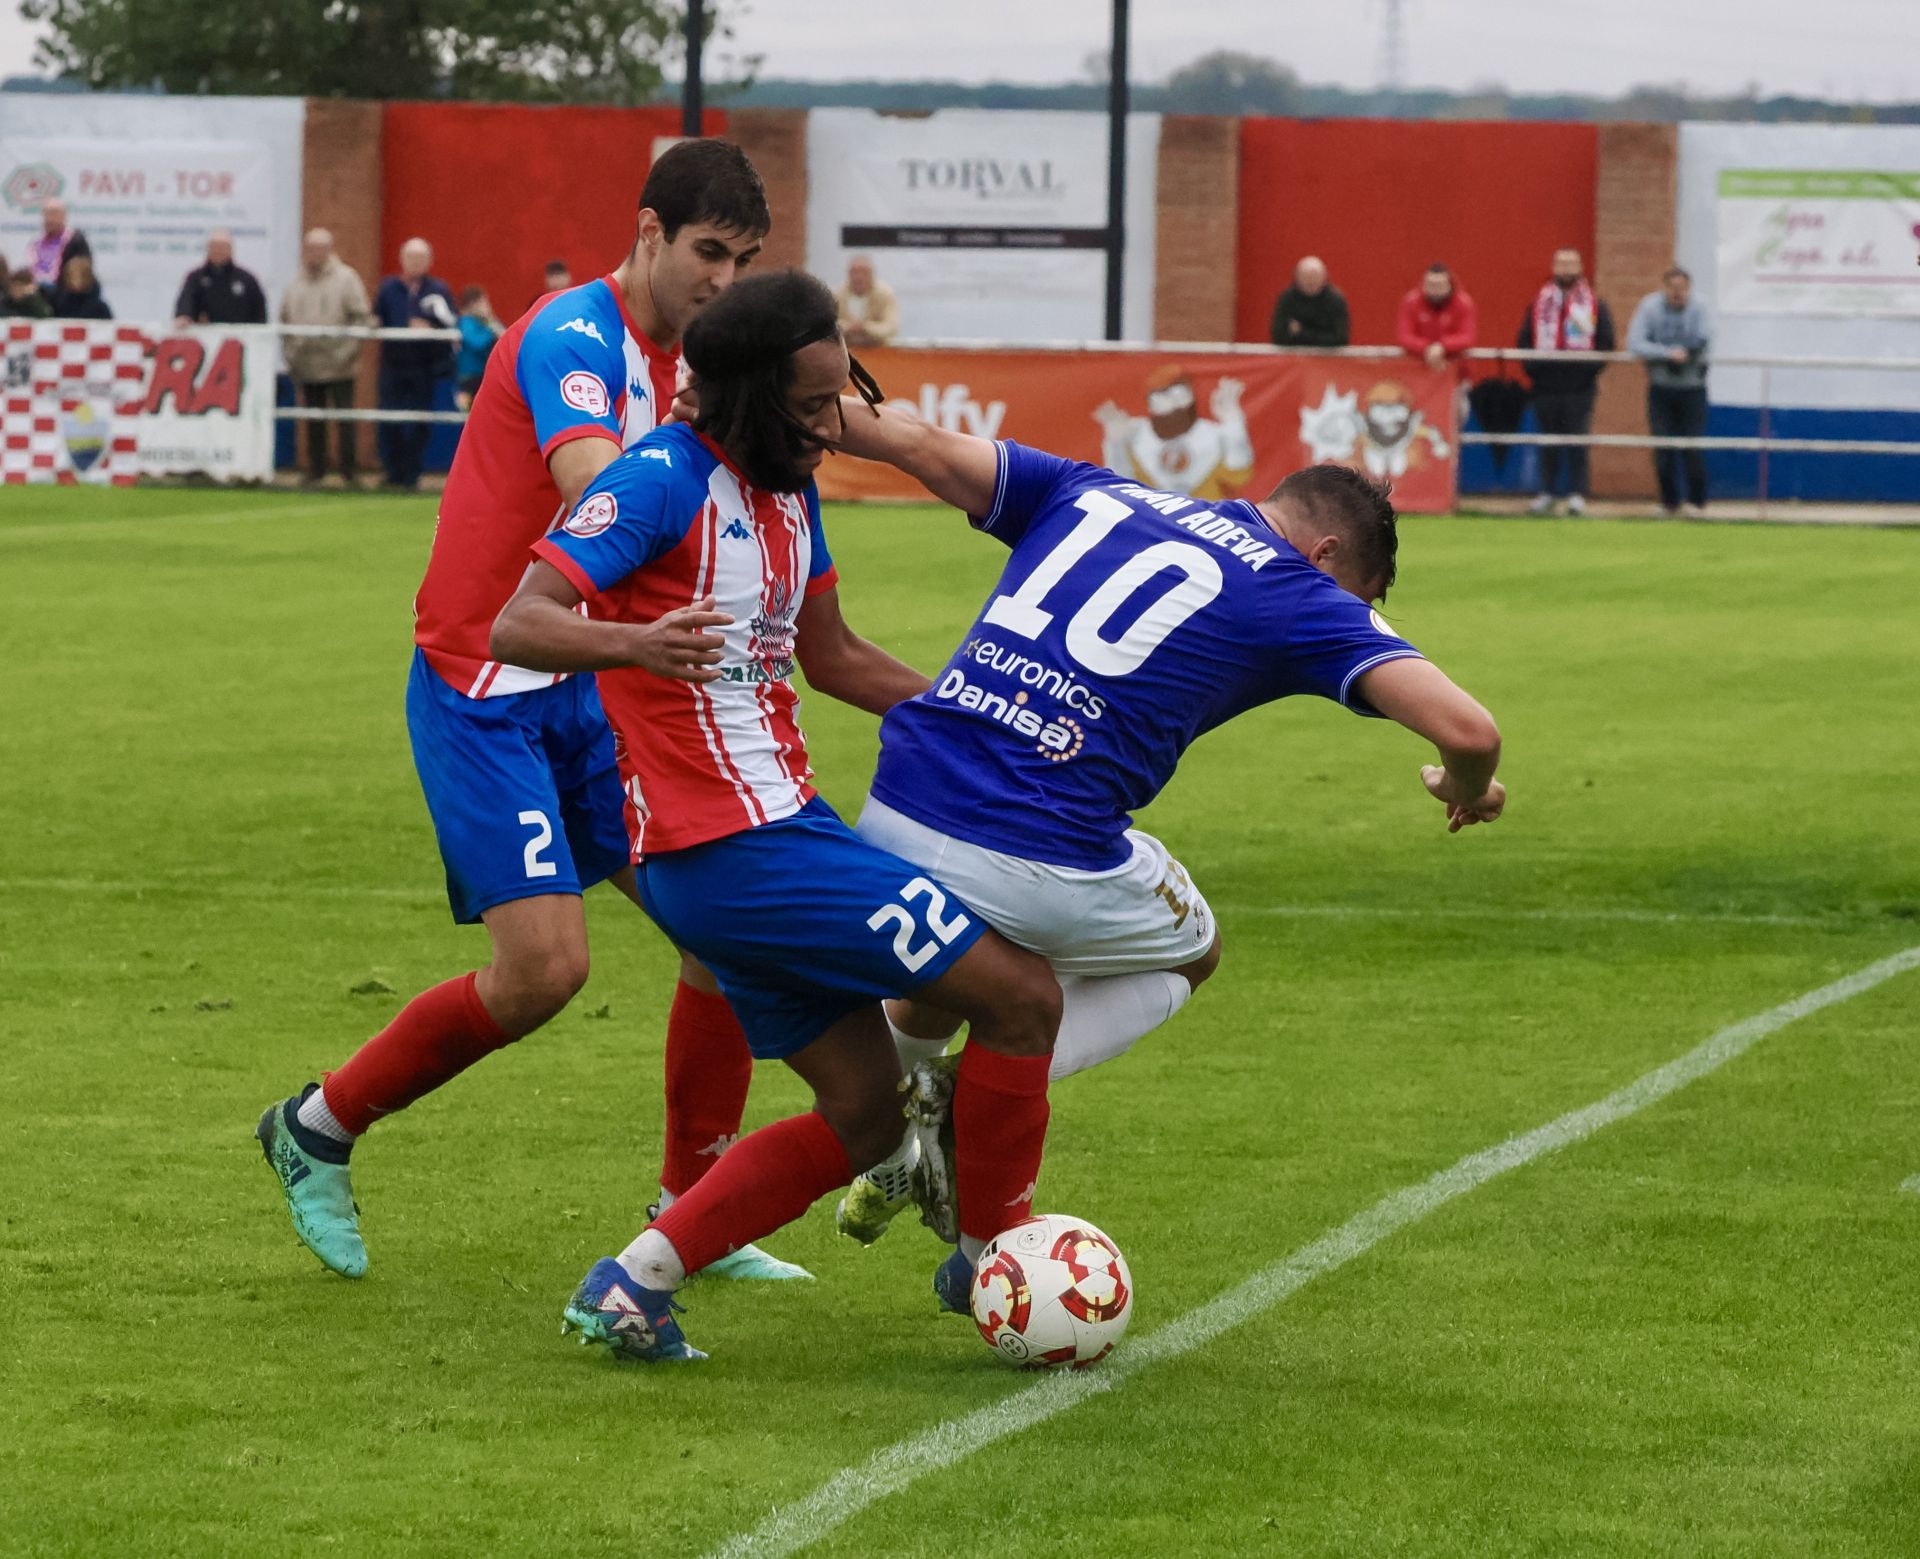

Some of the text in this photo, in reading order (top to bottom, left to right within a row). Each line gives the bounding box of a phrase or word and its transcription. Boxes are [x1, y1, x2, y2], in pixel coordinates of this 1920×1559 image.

[79, 169, 146, 195] PAVI
[175, 170, 235, 197] TOR
[902, 158, 1065, 197] TORVAL
[1176, 510, 1278, 572] ADEVA
[983, 490, 1224, 676] 10
[936, 669, 1072, 751] Danisa
[975, 641, 1107, 720] euronics
[518, 810, 557, 878] 2
[866, 877, 970, 973] 22
